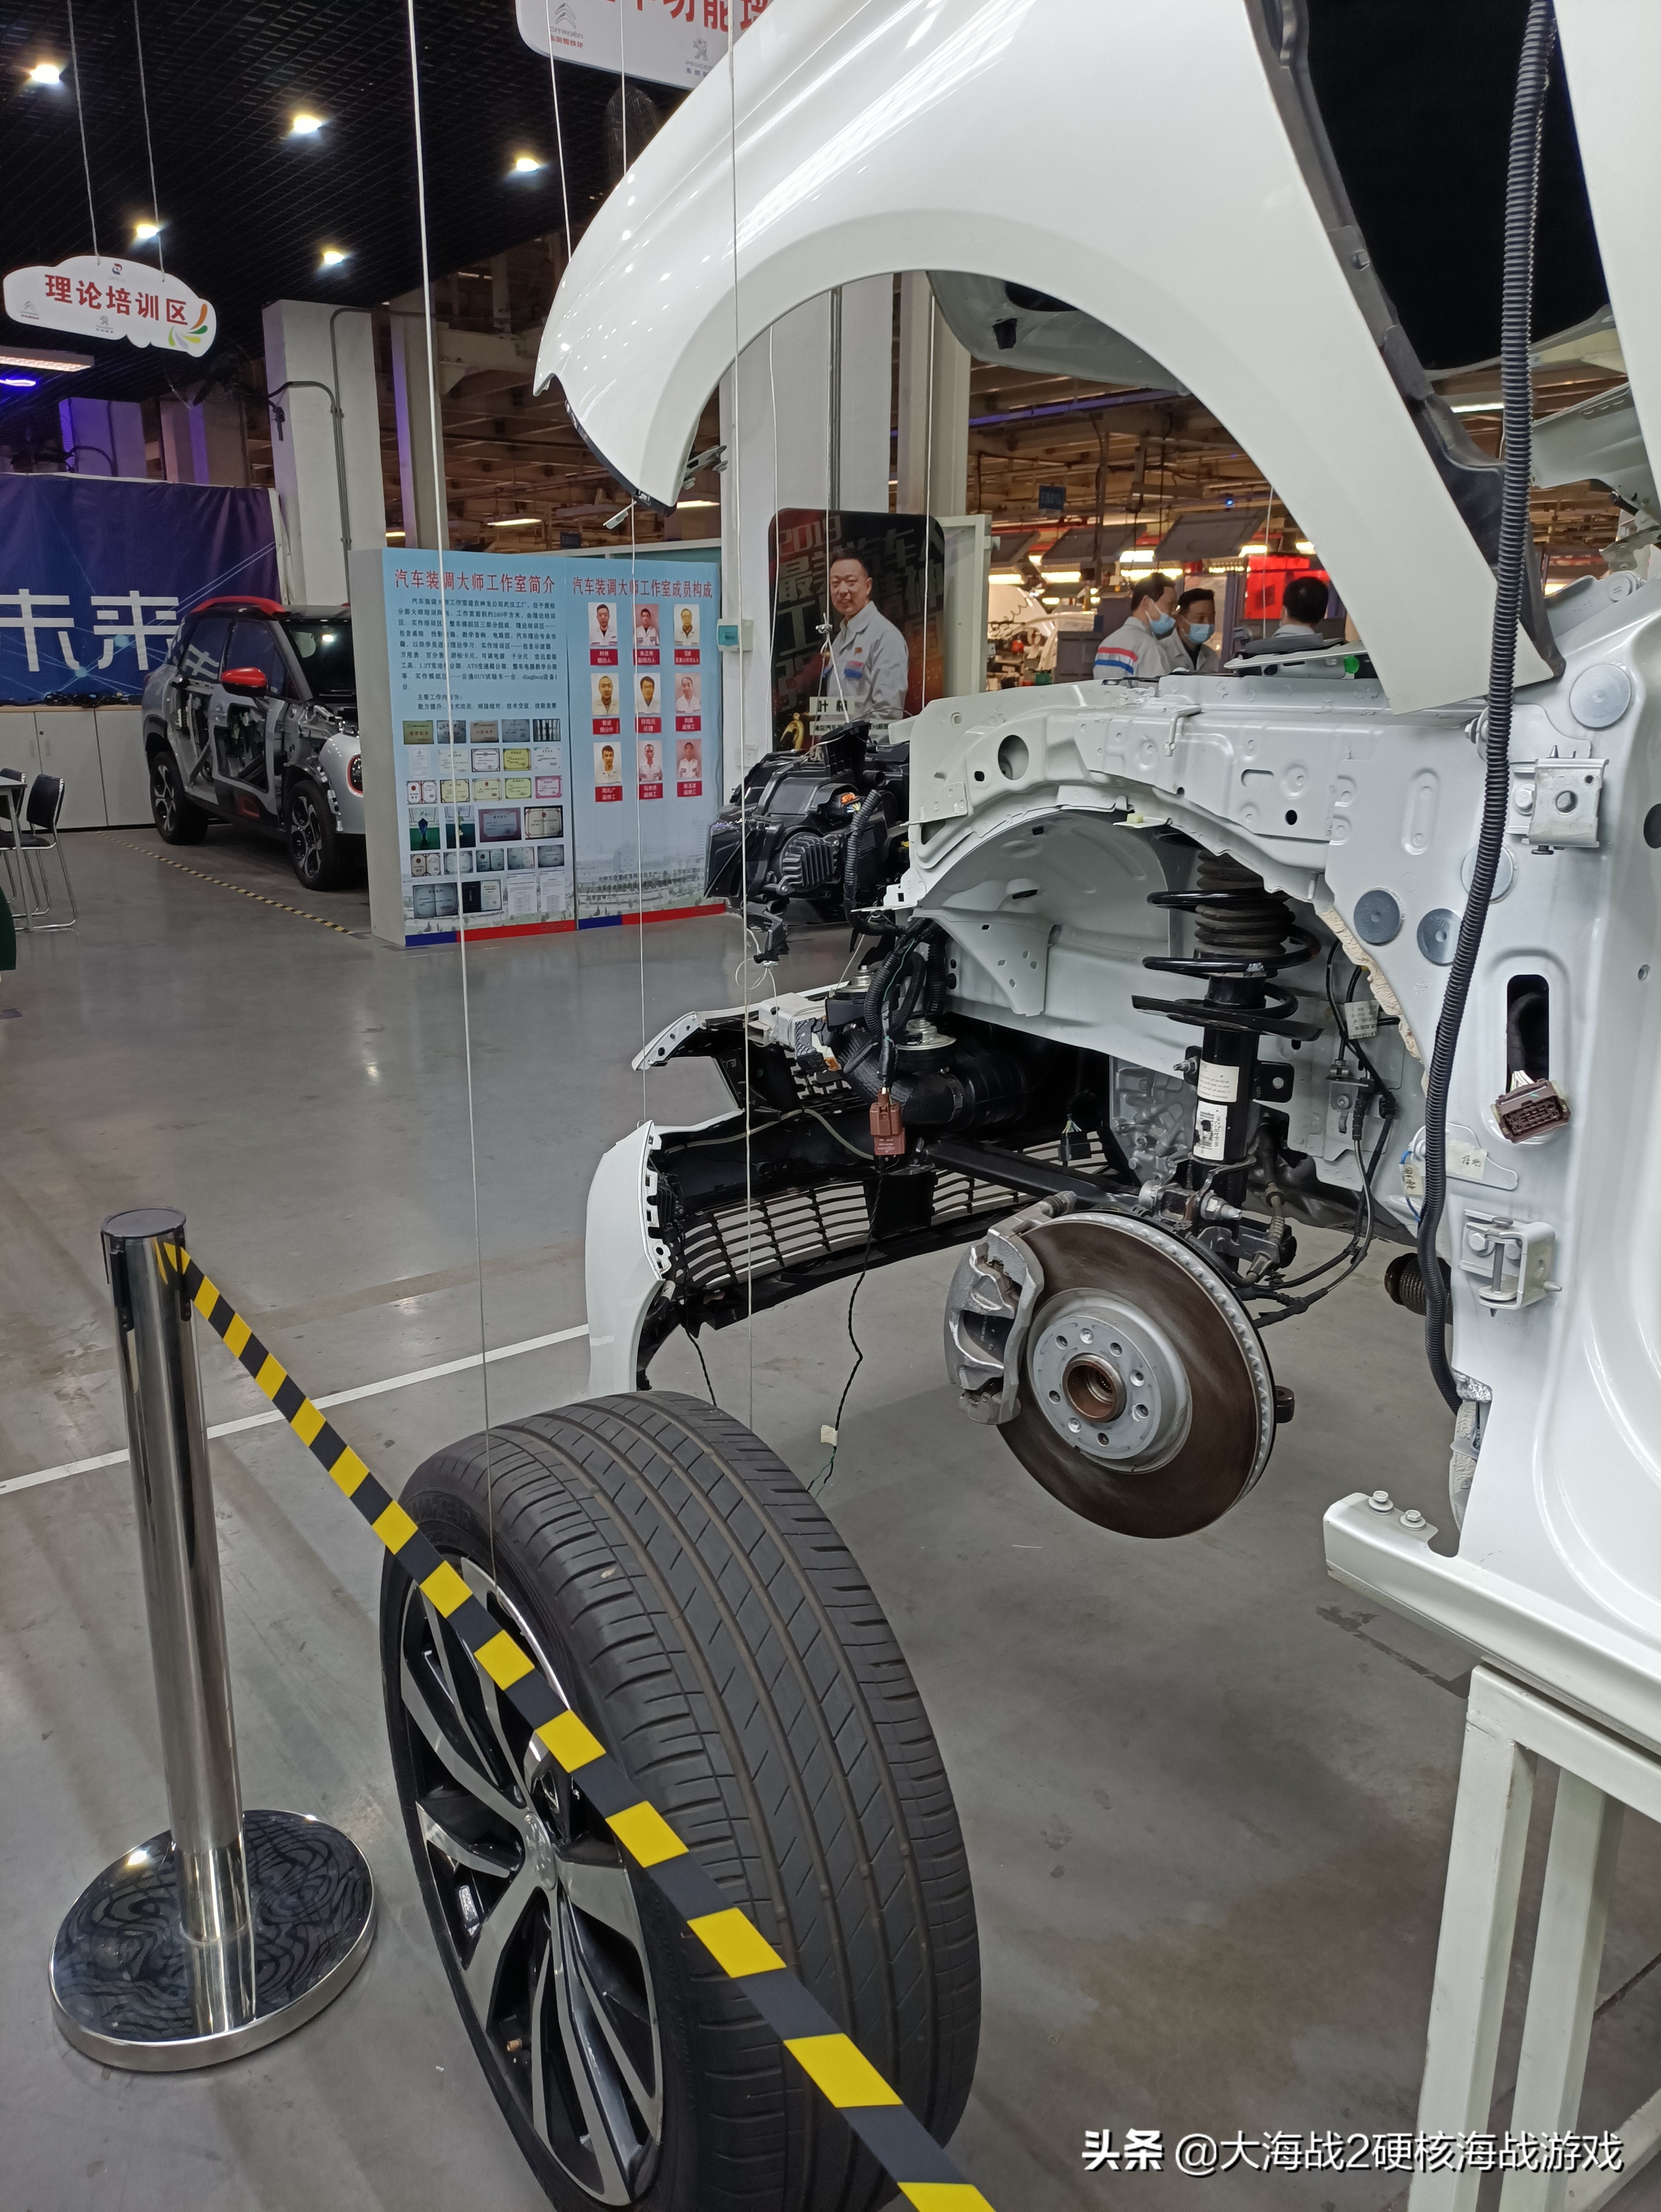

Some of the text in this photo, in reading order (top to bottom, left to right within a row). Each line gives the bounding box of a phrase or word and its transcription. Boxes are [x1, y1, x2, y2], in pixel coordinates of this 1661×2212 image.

[44, 274, 188, 326] 理论培训区
[395, 568, 555, 594] 汽车装调大师工作室简介
[573, 576, 712, 598] 汽车装调大师工作室成员构成
[0, 588, 179, 672] 未来
